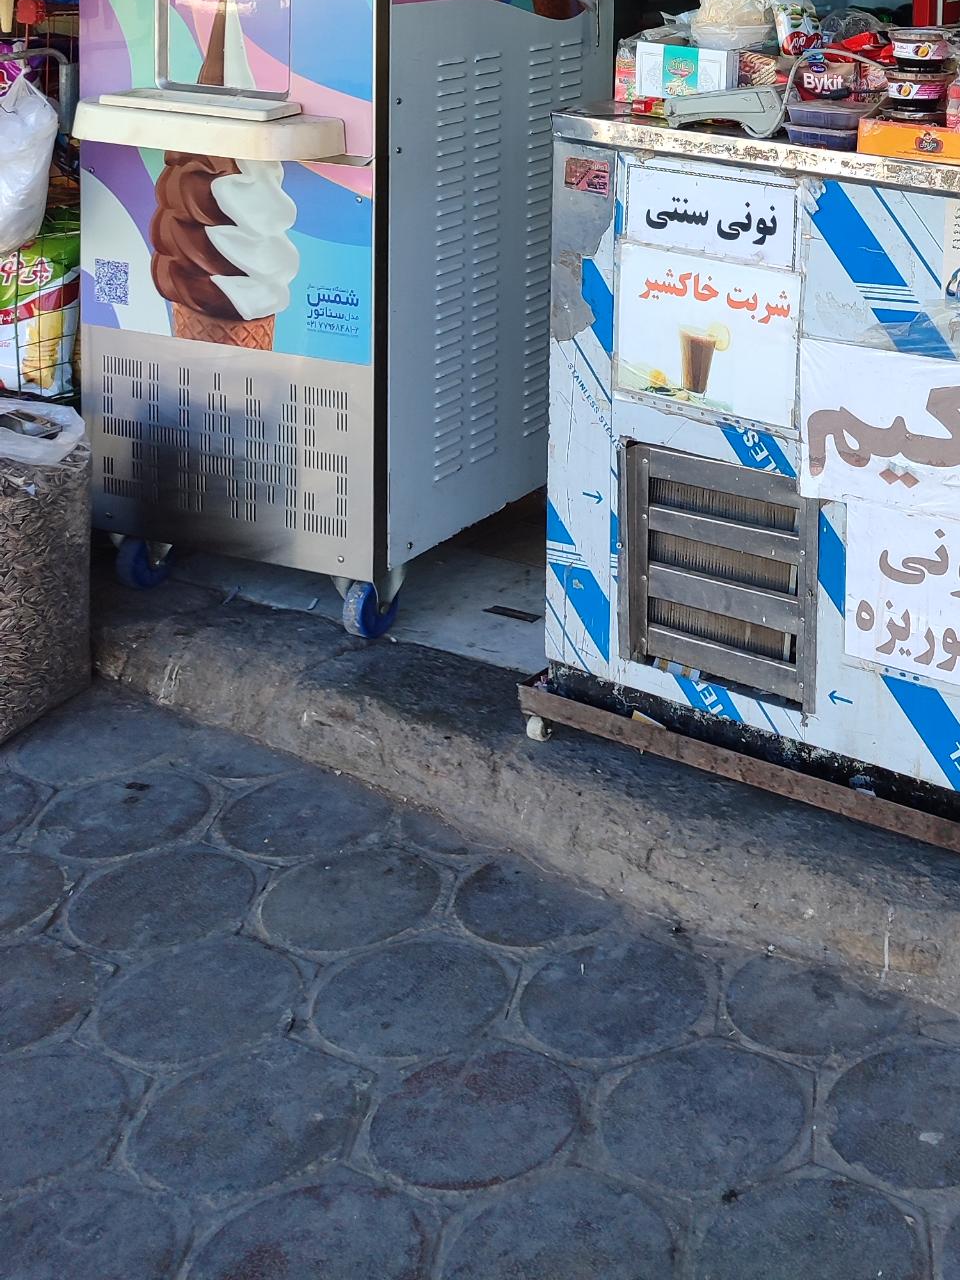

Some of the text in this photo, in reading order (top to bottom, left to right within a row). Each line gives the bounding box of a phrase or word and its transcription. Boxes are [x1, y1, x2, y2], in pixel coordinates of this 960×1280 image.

[803, 73, 844, 92] Bykit
[645, 197, 777, 245] نونی سنتی
[307, 290, 359, 307] شمس
[639, 269, 791, 324] شربت خاکشیر
[307, 307, 360, 321] مدل سناتور
[567, 362, 600, 414] STAINLESS
